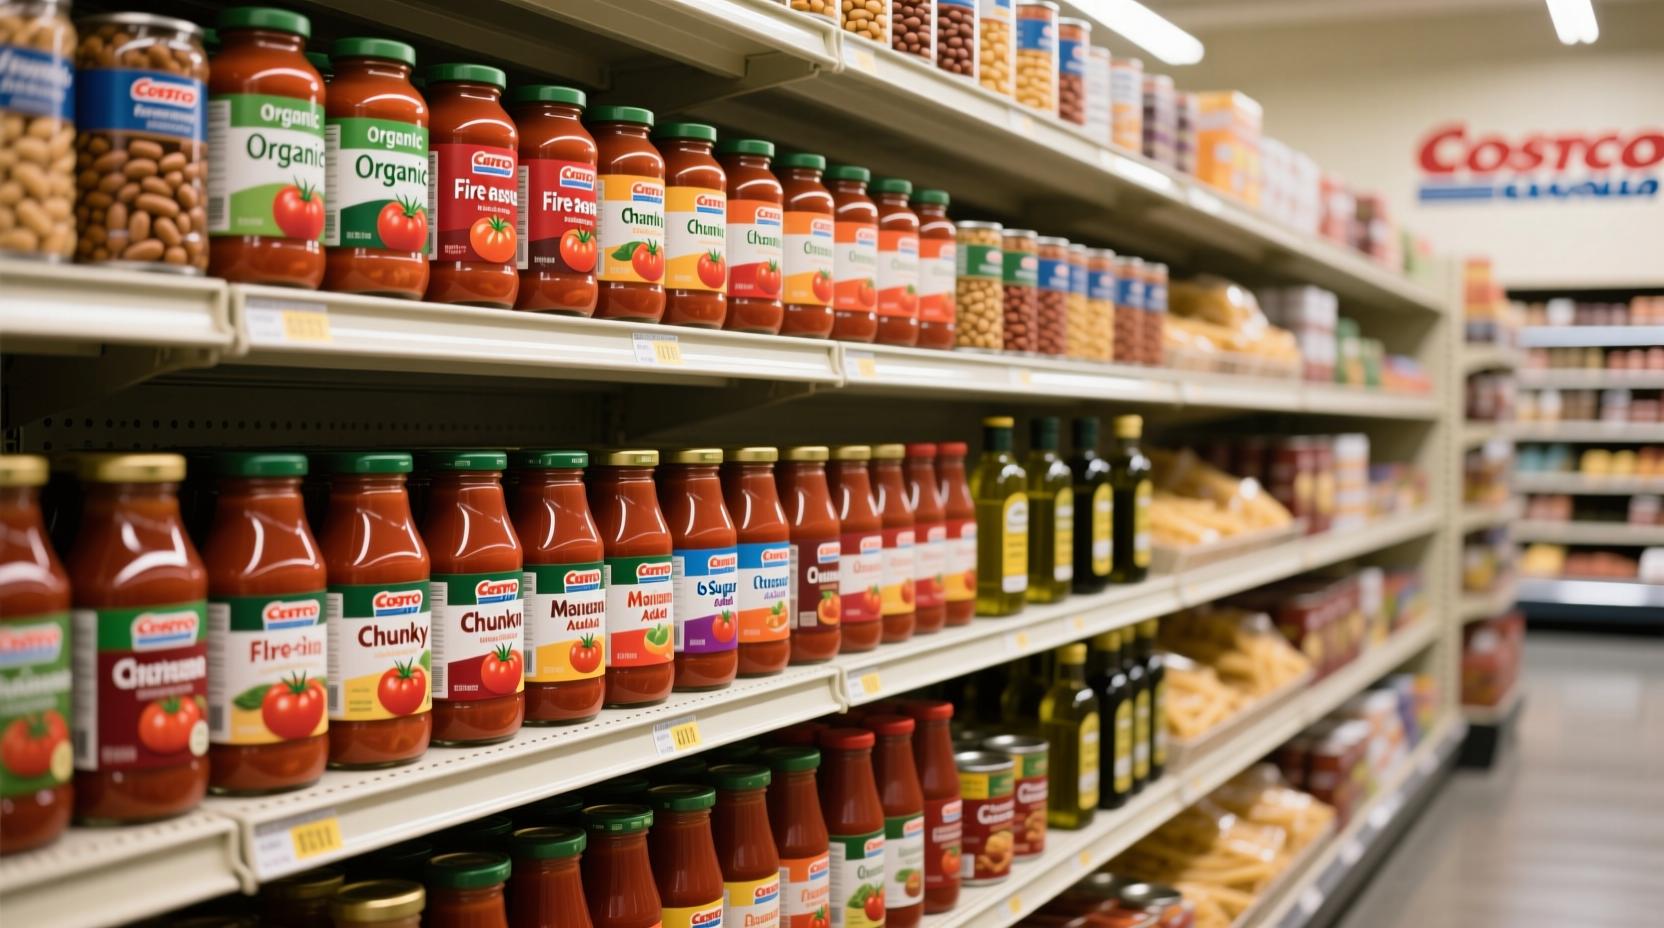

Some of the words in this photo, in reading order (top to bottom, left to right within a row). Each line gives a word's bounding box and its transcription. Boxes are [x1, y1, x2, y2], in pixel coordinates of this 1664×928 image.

[259, 103, 320, 129] Organic
[367, 126, 423, 150] Organic
[355, 154, 429, 187] Organic
[455, 178, 485, 201] Fire
[543, 191, 573, 213] Fire
[358, 621, 429, 649] Chunky
